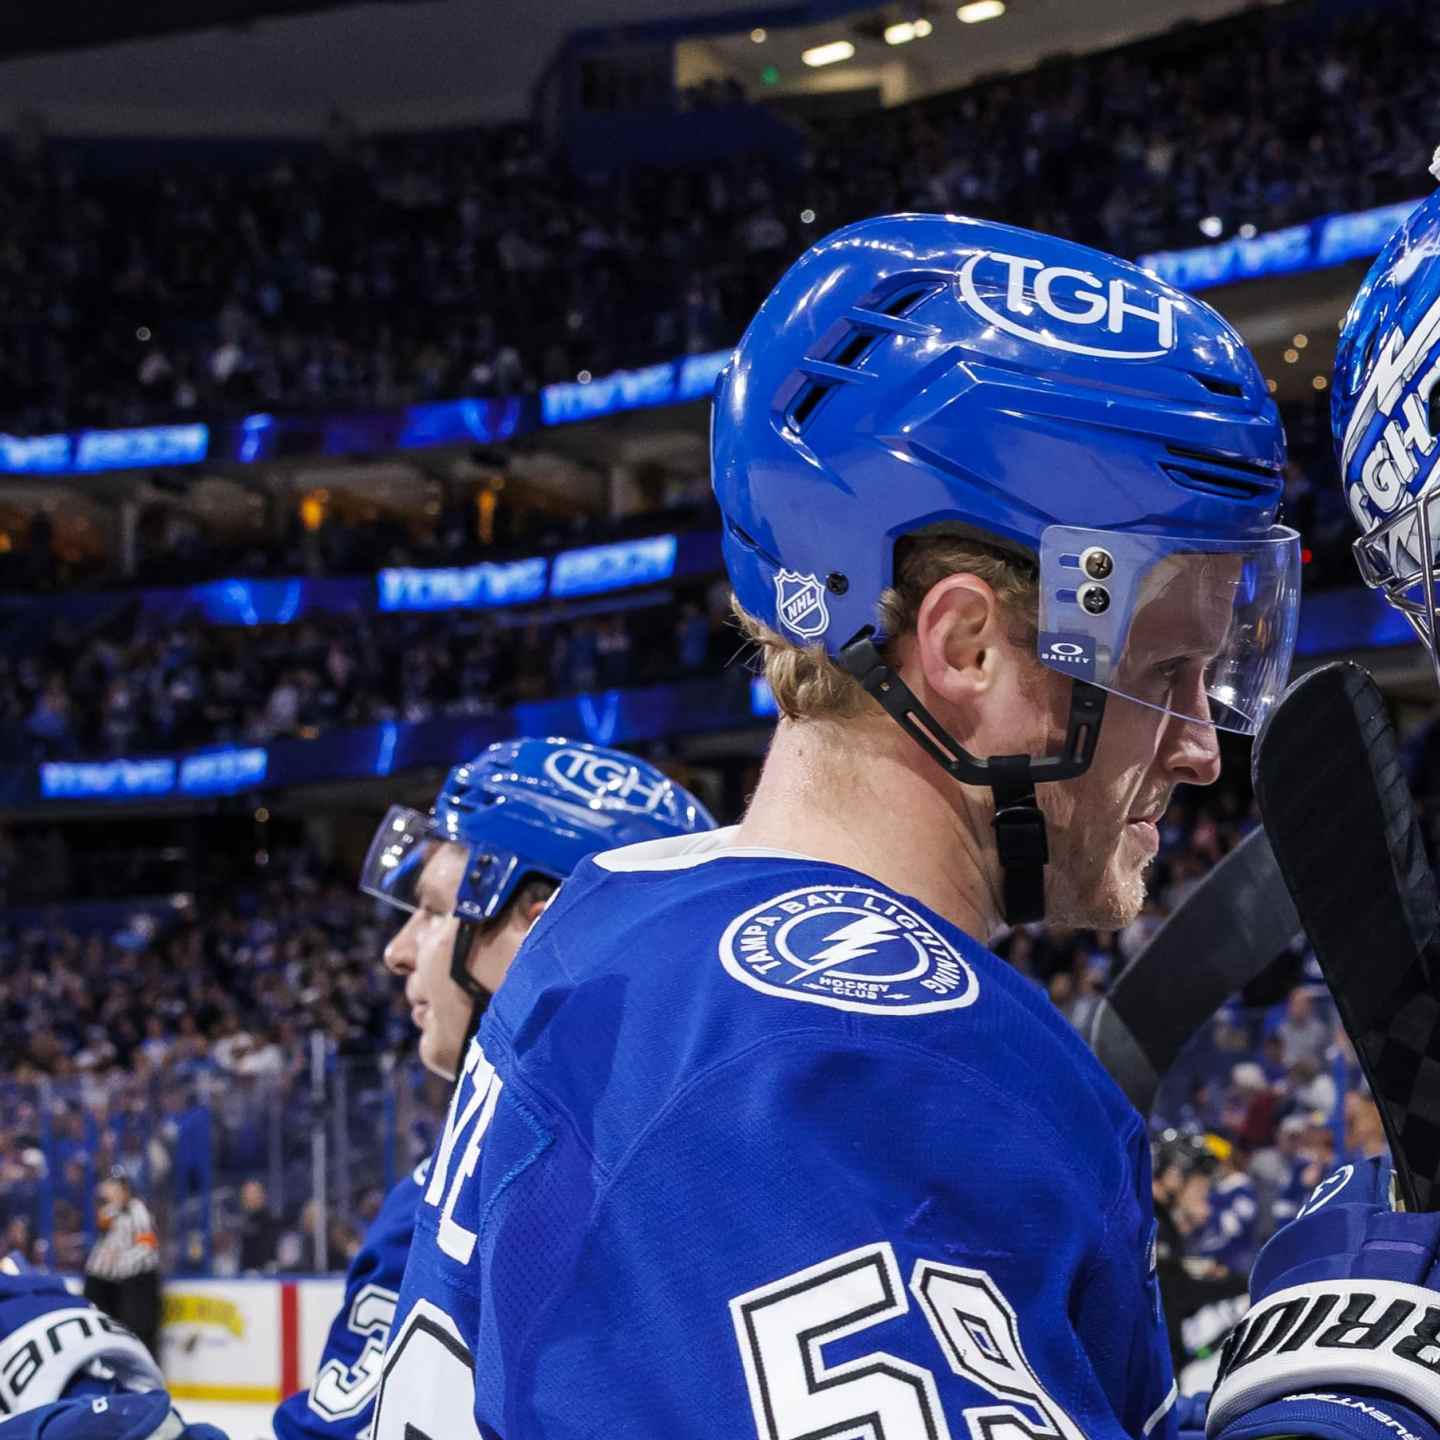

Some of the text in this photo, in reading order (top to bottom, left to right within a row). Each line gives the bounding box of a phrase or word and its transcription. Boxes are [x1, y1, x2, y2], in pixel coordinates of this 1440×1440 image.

[988, 252, 1175, 350] TGH
[787, 591, 815, 620] NHL
[564, 753, 667, 813] TGH
[740, 892, 961, 994] TAMPA BAY LIGHTNING
[819, 977, 890, 993] HOCKEY
[832, 987, 879, 1000] CLUB
